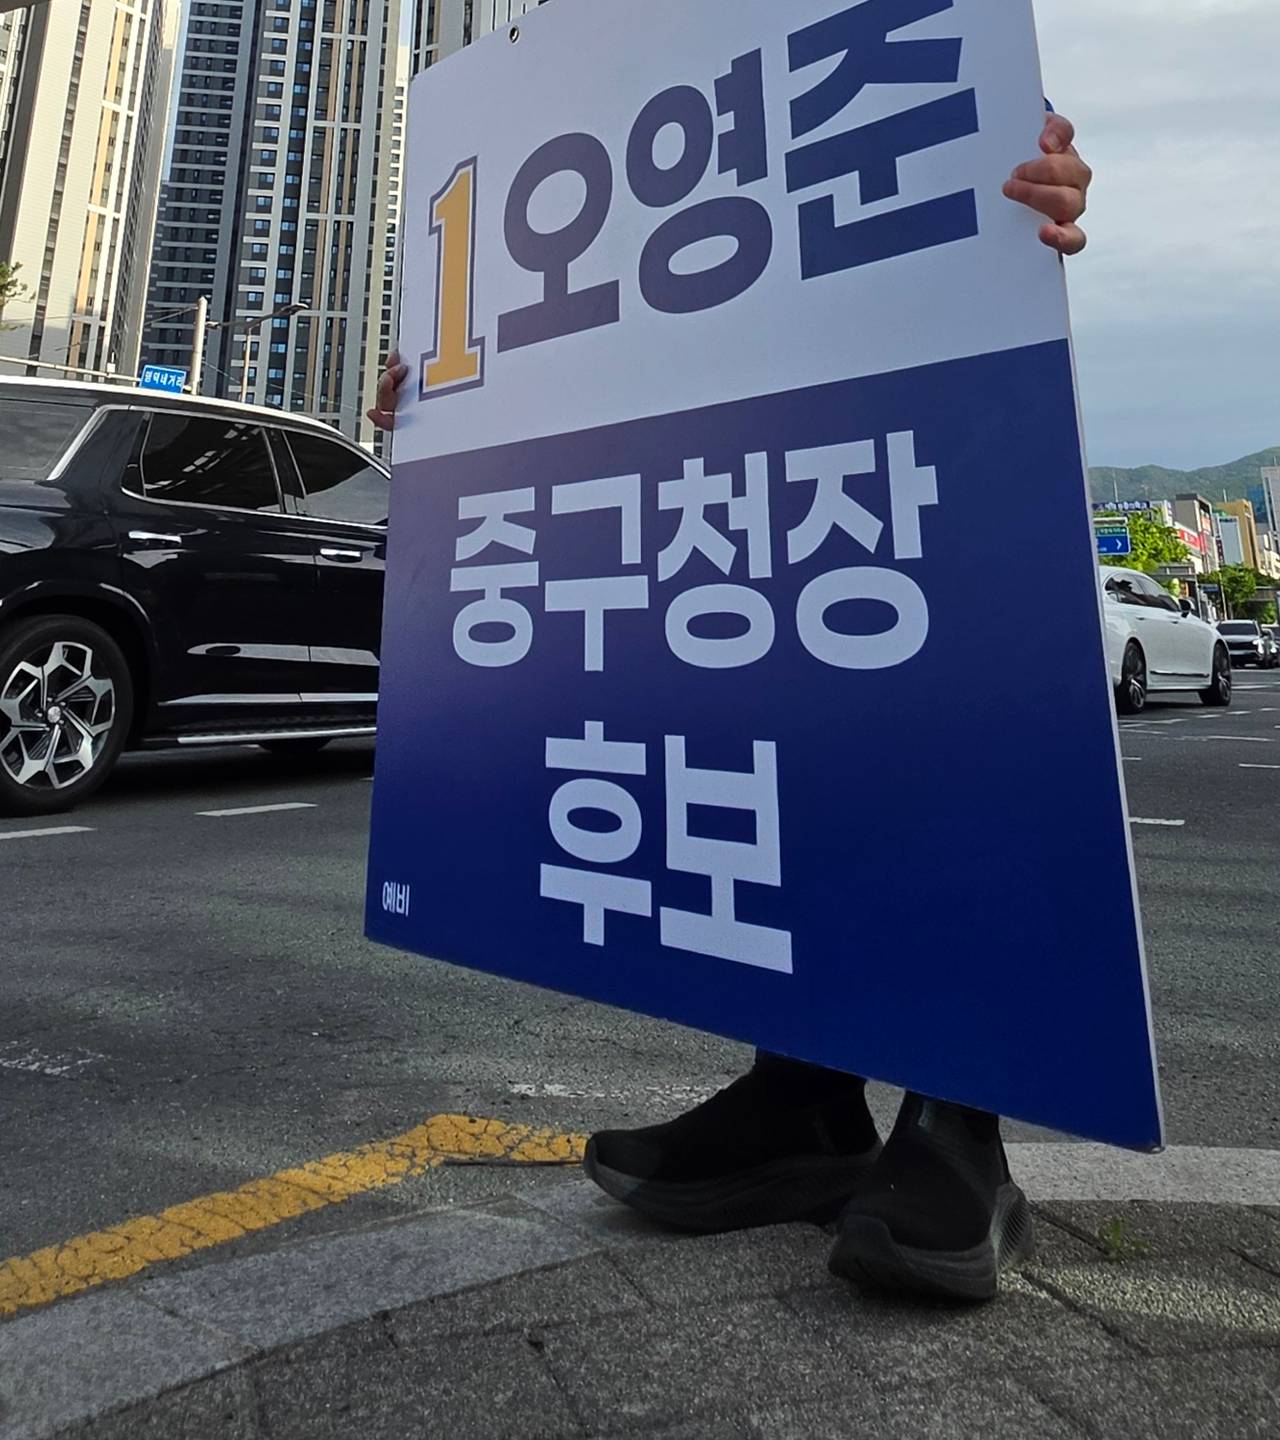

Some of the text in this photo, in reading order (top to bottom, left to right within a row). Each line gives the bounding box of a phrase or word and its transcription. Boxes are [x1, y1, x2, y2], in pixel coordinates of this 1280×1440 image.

[418, 156, 485, 400] 1
[449, 429, 939, 672] 중구청장
[382, 880, 410, 917] 예비
[539, 720, 794, 974] 후보
